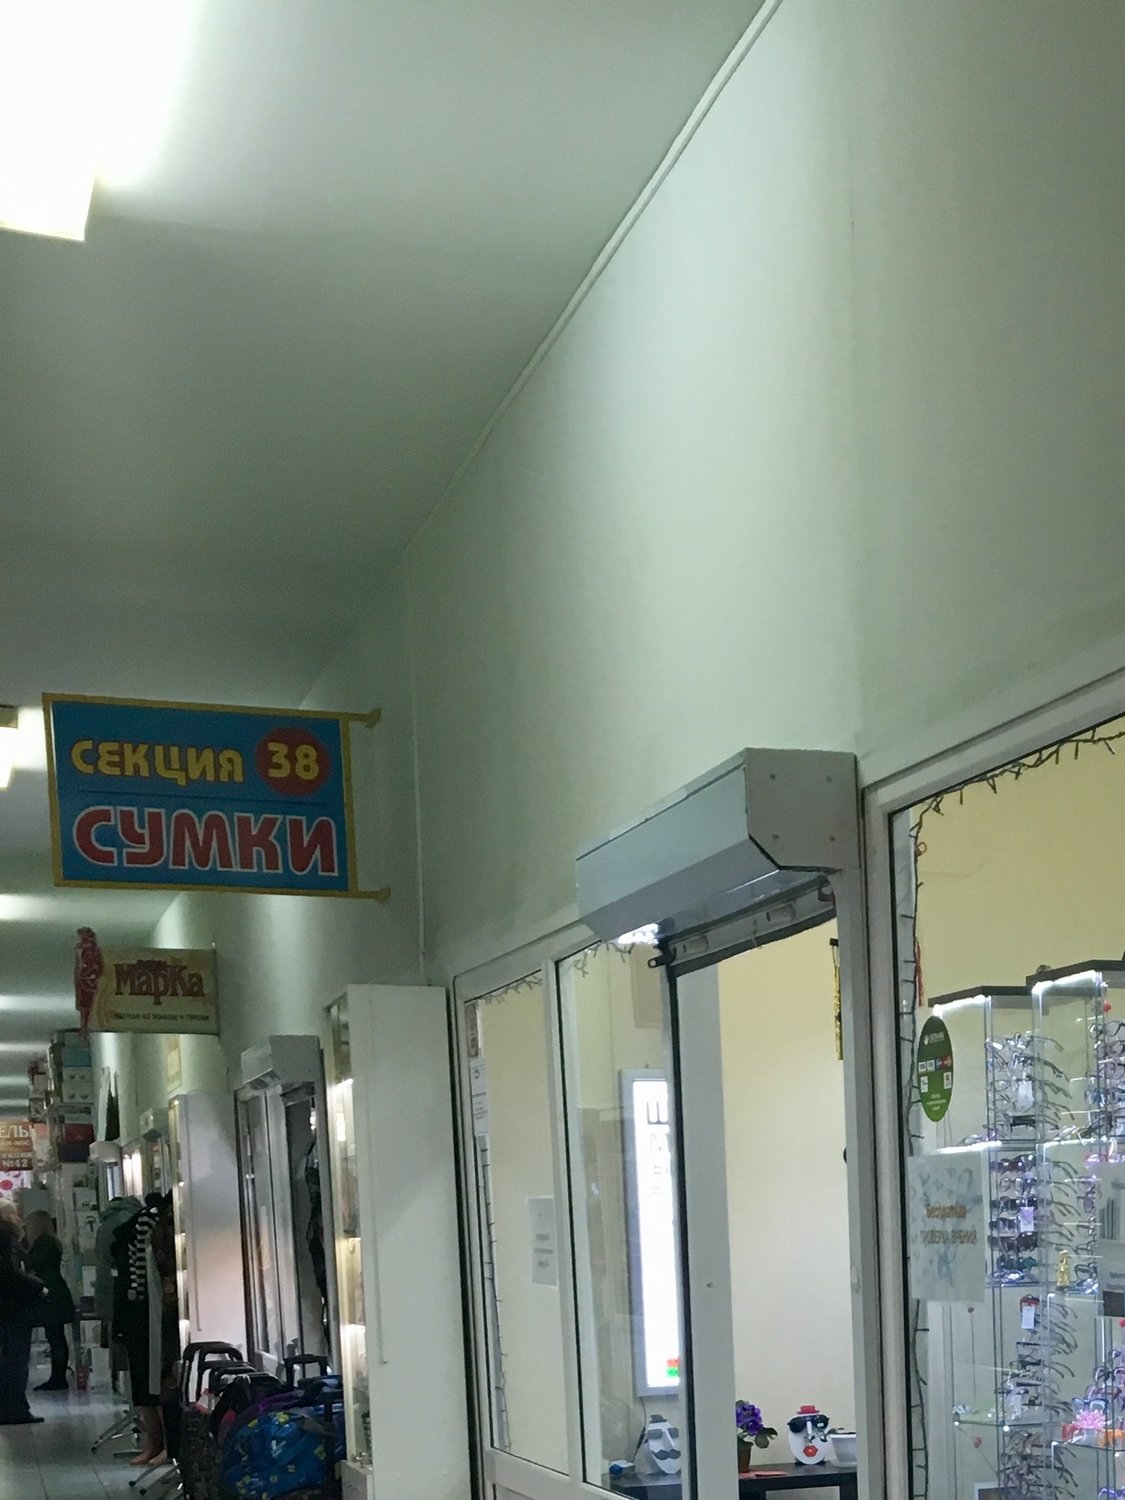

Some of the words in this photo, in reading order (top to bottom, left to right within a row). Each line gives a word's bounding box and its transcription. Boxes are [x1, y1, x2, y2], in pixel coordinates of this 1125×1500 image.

[71, 739, 244, 786] СЕКЦИЯ
[267, 742, 320, 780] 38
[73, 805, 339, 877] СУМКИ
